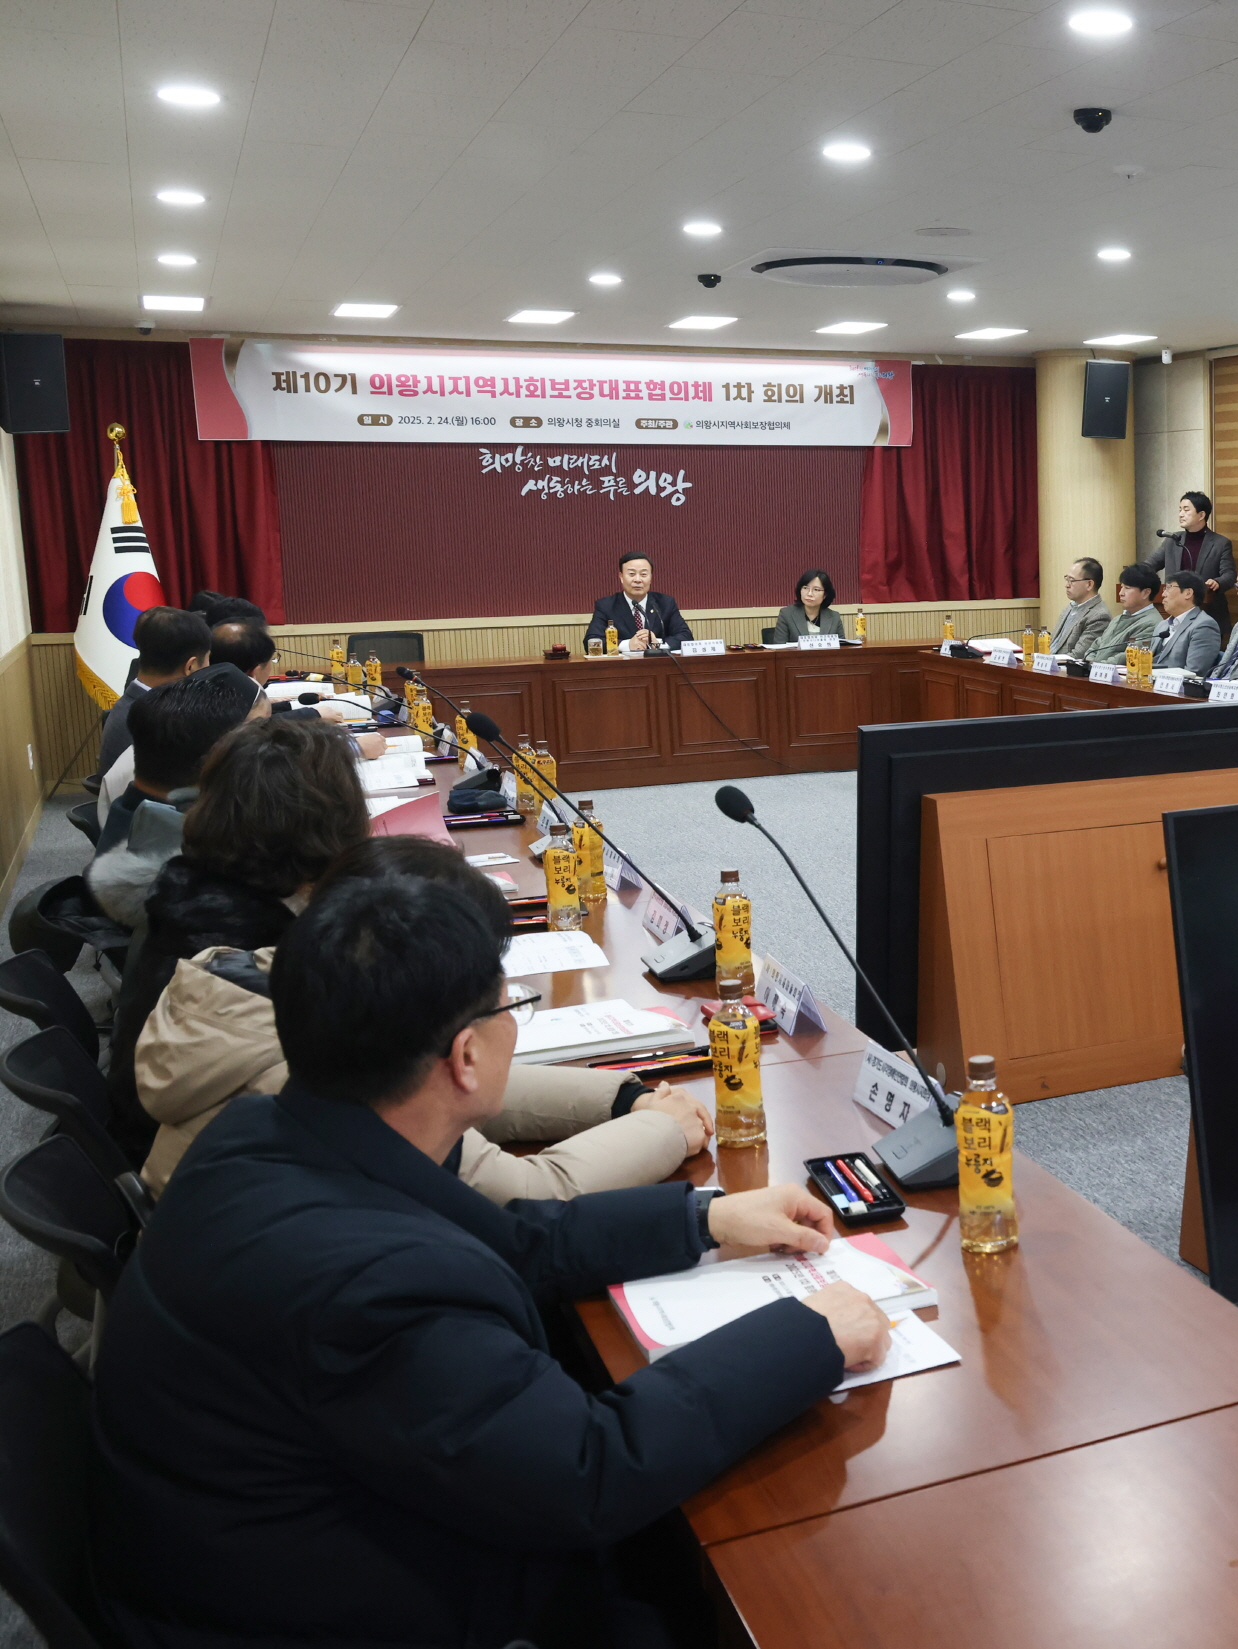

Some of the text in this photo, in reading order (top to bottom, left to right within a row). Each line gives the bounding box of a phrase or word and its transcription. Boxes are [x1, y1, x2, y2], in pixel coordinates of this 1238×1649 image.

[271, 370, 855, 405] 제10기 의왕시지역사회보장대표협의체 1차 회의 개최
[397, 416, 424, 426] 2025.
[426, 416, 435, 426] 2.
[470, 416, 496, 426] 16:00
[547, 417, 583, 428] 의왕시청
[585, 417, 621, 429] 중회의실
[695, 420, 791, 431] 의왕시지역사회보장협의체
[478, 445, 617, 475] 희망찬 미래도시
[520, 468, 693, 506] 생동하는 푸른 의왕
[553, 855, 570, 865] 블랙
[554, 866, 571, 875] 보리
[732, 917, 749, 927] 보리
[711, 1046, 730, 1059] 보리
[869, 1082, 911, 1124] 손명자
[962, 1117, 991, 1134] 블랙
[963, 1136, 992, 1151] 보리
[965, 1153, 993, 1175] 누룽지
